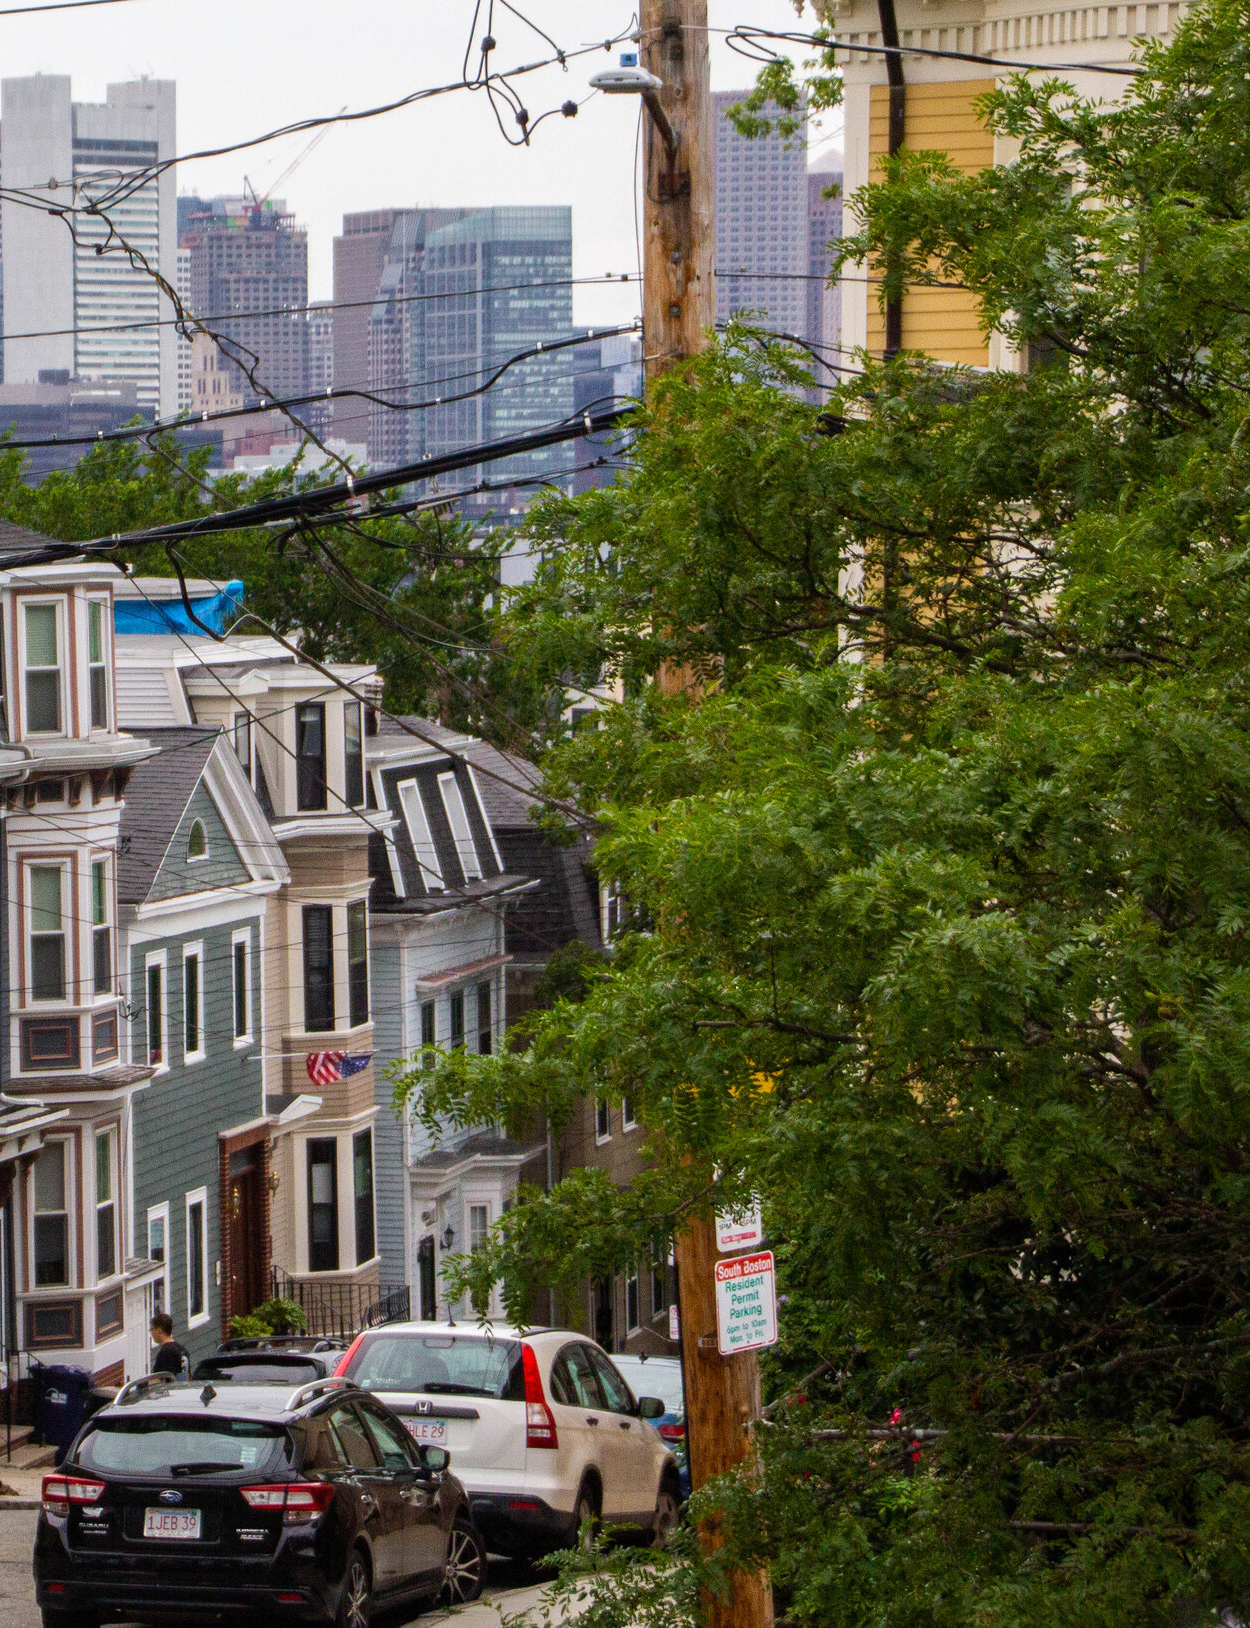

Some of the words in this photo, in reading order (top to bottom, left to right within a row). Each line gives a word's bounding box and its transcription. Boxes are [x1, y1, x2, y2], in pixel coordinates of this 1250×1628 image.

[718, 1263, 742, 1280] South
[743, 1259, 771, 1274] Boston
[725, 1275, 764, 1293] Resident
[731, 1290, 760, 1305] Permit
[730, 1304, 763, 1319] Parking
[746, 1332, 753, 1340] to
[402, 1424, 428, 1438] HLE
[430, 1425, 445, 1439] 29
[148, 1515, 178, 1531] 1JEB
[181, 1516, 197, 1531] 39
